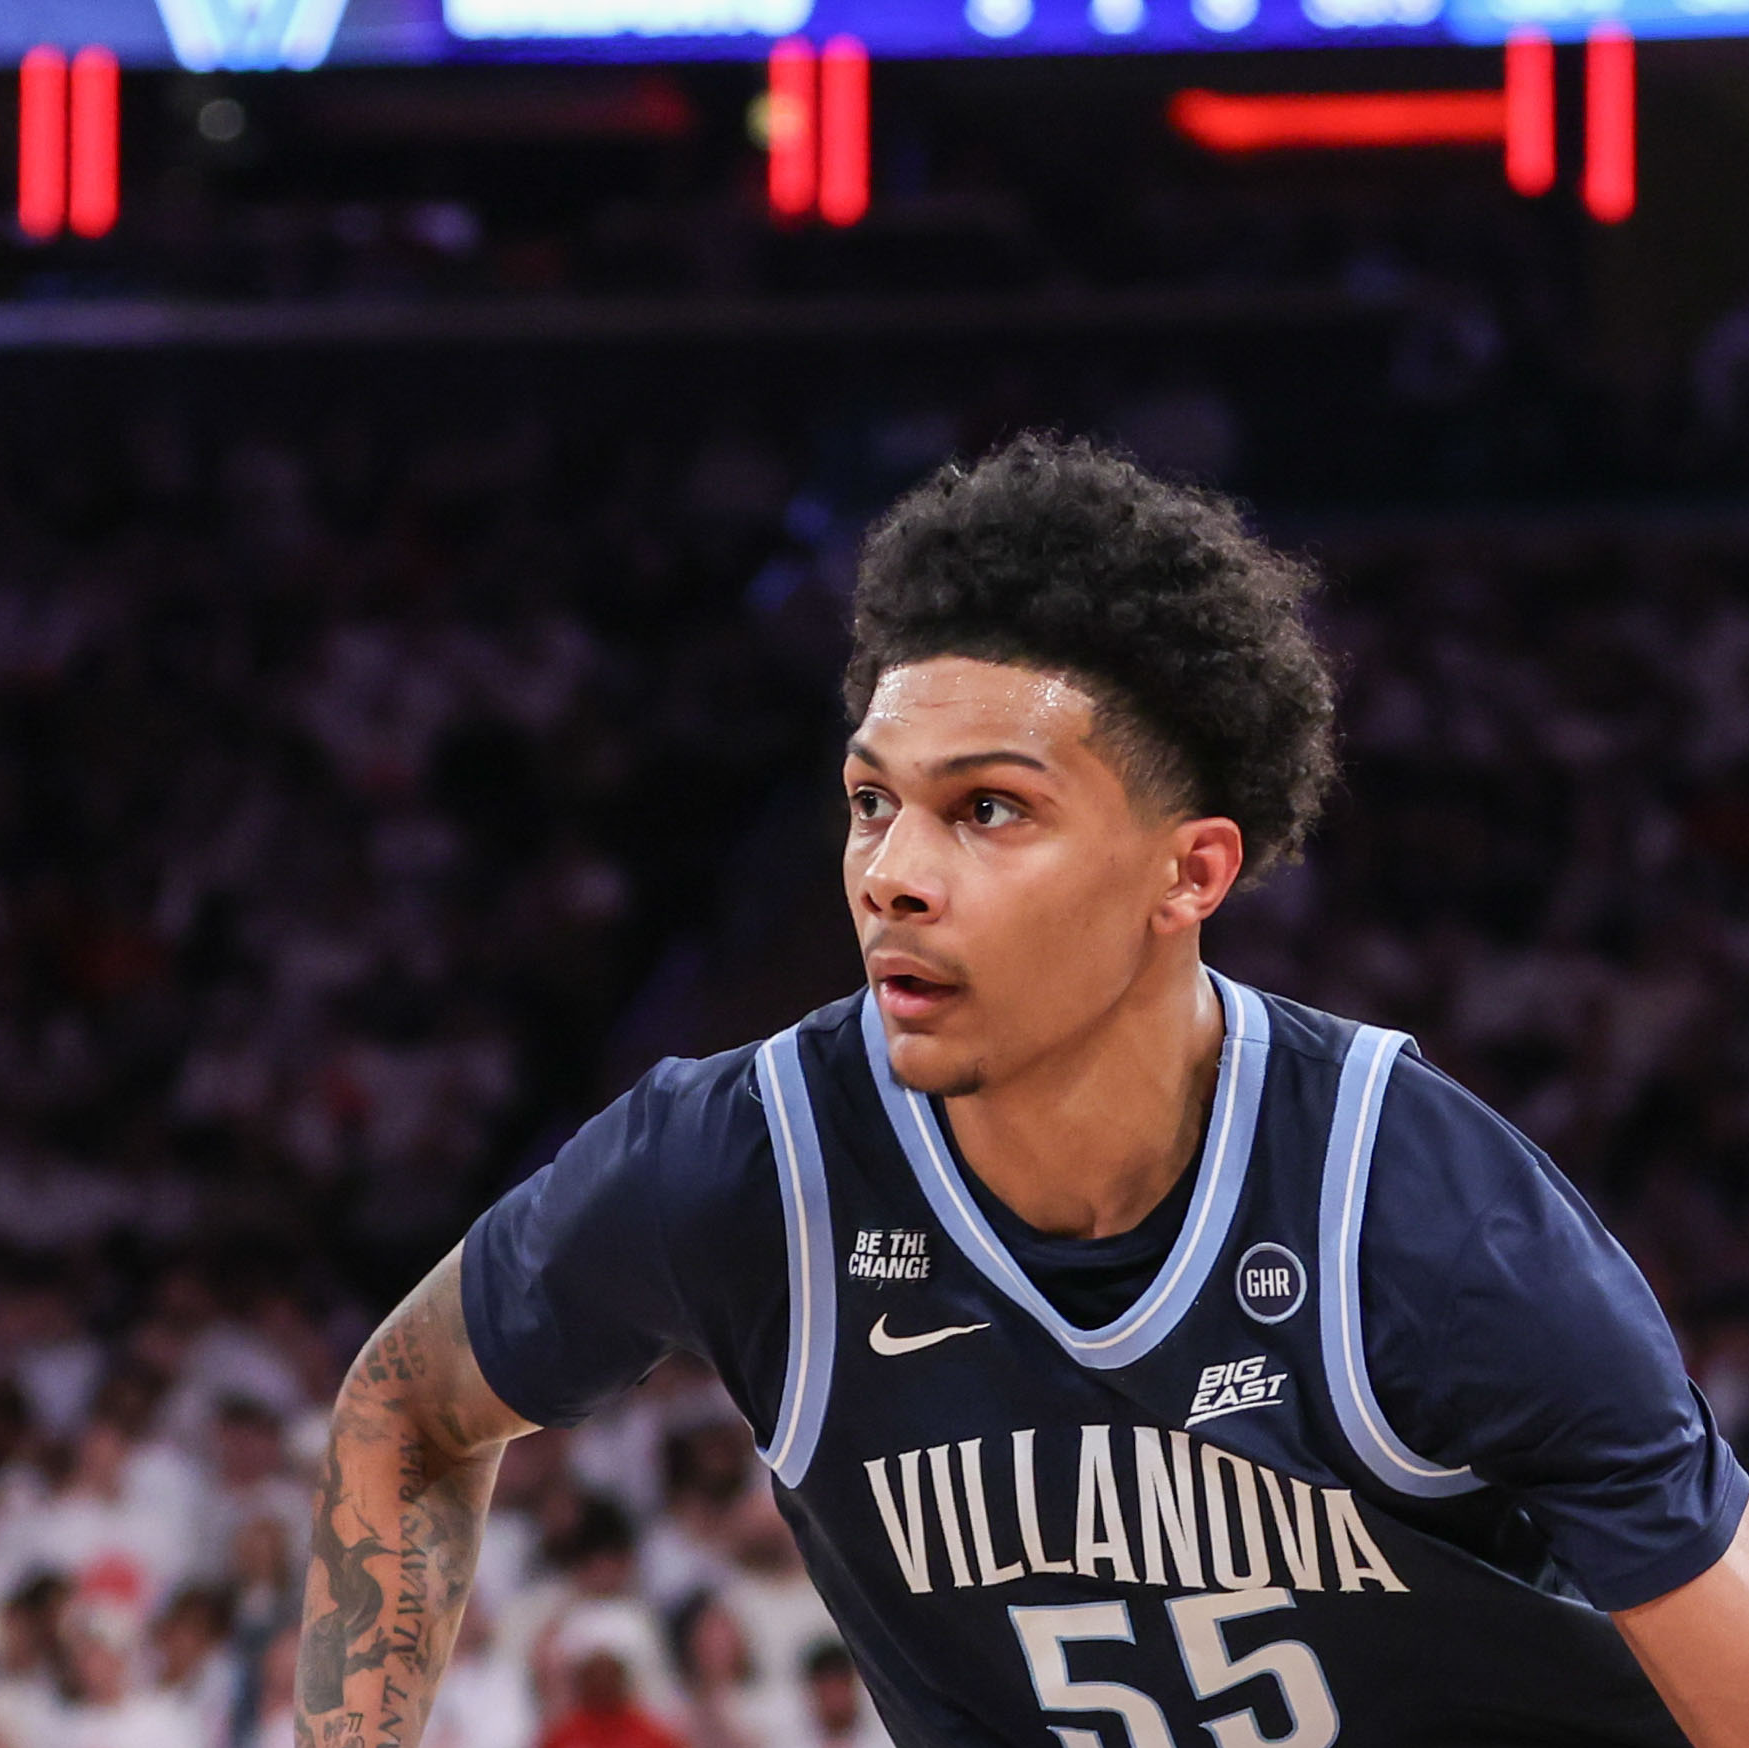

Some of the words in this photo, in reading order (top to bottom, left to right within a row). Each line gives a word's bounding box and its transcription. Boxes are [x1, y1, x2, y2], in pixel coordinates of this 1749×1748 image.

[855, 1231, 883, 1255] BE
[890, 1233, 927, 1256] THE
[848, 1252, 931, 1279] CHANGE
[1246, 1267, 1290, 1298] GHR
[1198, 1355, 1267, 1392] BIG
[1190, 1373, 1288, 1414] EAST
[863, 1424, 1411, 1594] VILLANOVA
